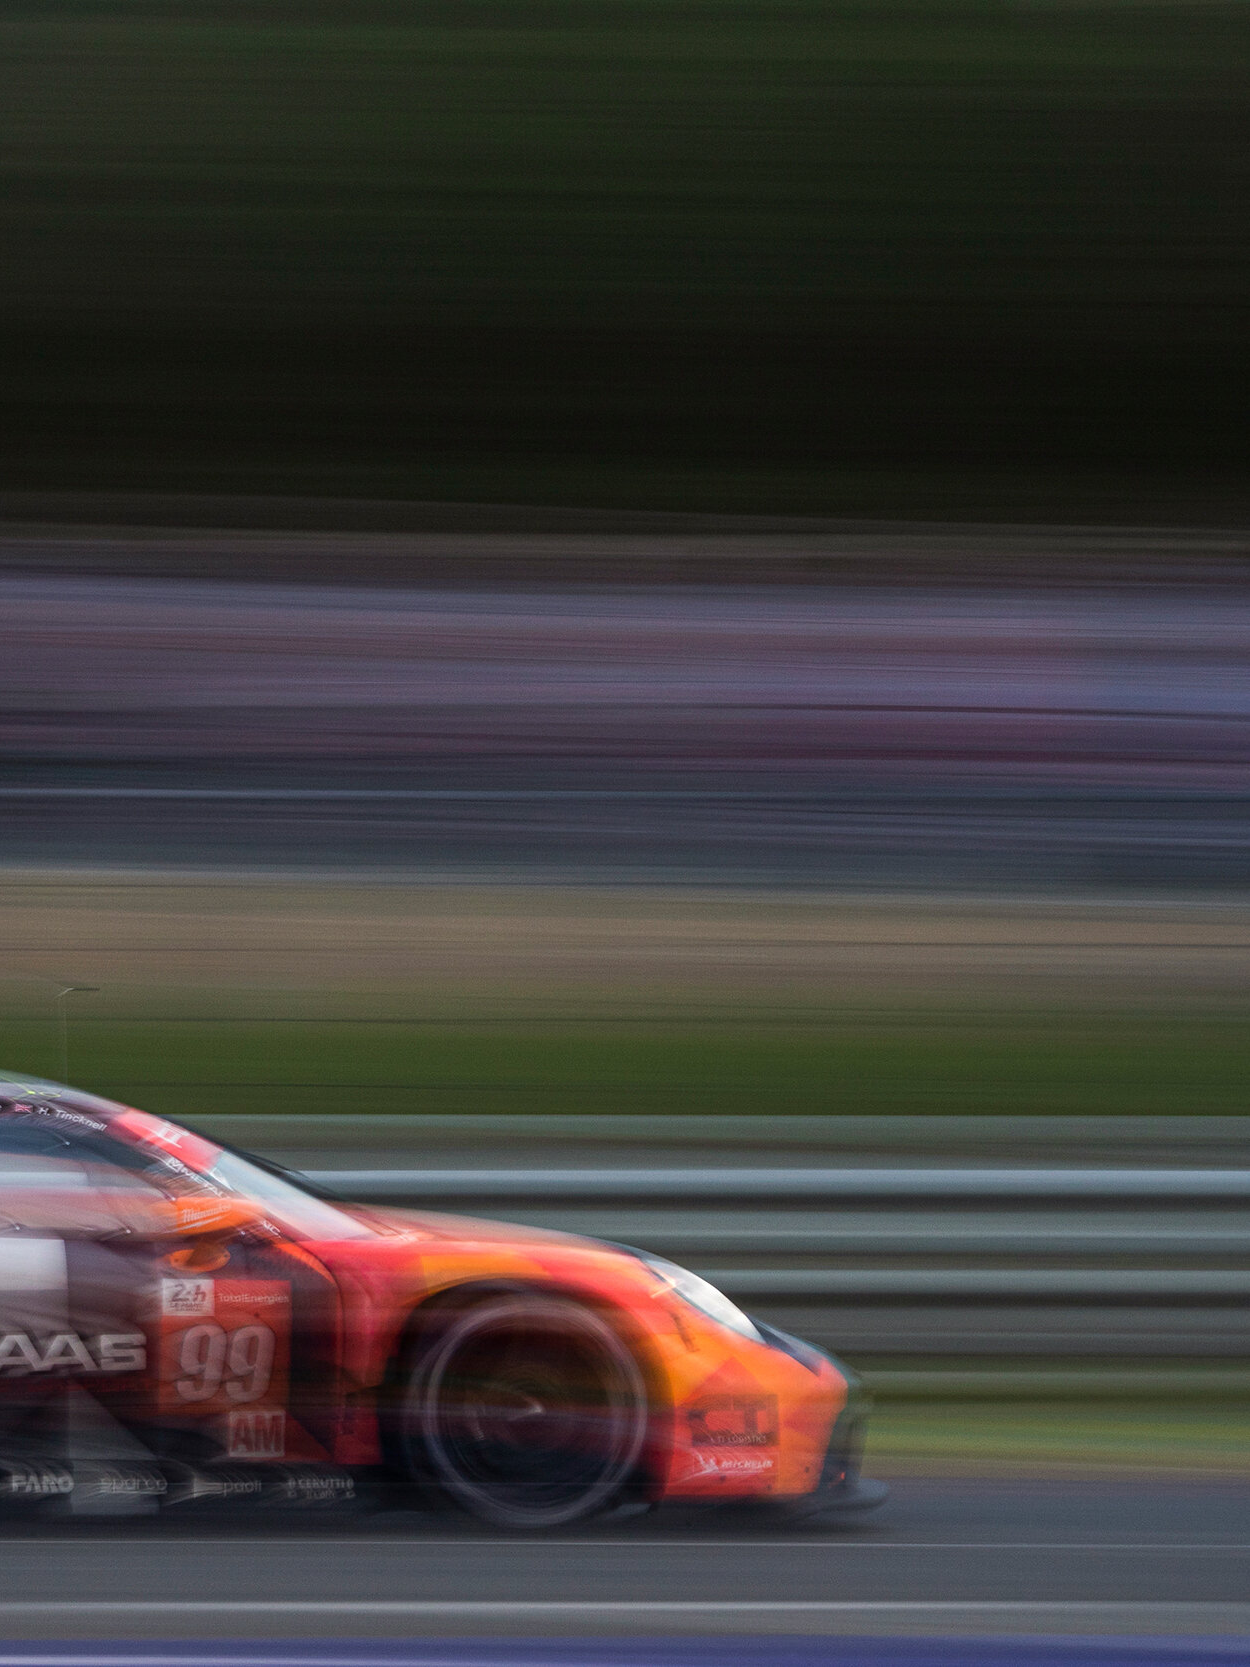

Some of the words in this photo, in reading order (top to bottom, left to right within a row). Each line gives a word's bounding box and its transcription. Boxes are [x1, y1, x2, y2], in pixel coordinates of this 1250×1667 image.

[176, 1324, 277, 1401] 99
[232, 1412, 284, 1454] AM
[11, 1475, 75, 1494] FARO
